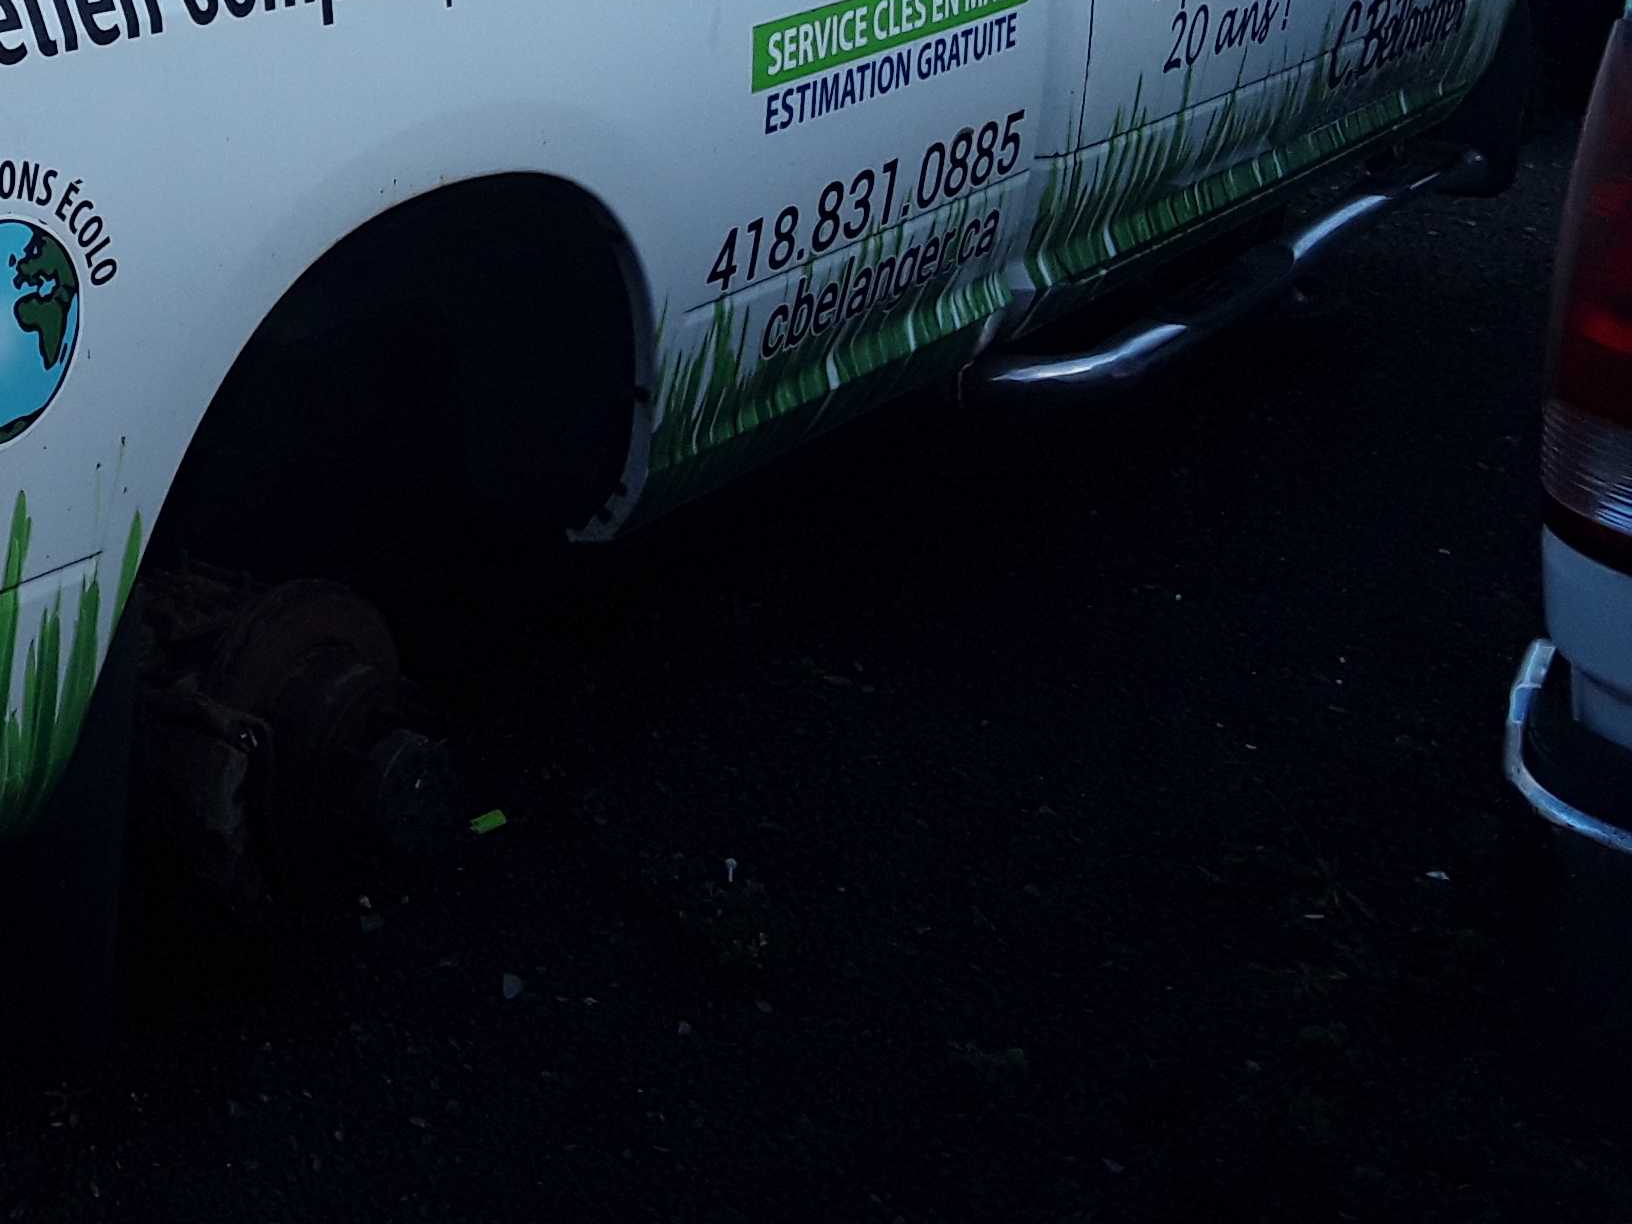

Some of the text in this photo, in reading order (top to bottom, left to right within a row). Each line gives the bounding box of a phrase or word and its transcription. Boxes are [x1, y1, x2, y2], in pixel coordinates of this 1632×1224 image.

[765, 13, 1017, 134] ESTIMATION GRATUITE
[767, 6, 868, 75] SERVICE
[1163, 4, 1209, 73] 20
[55, 179, 117, 286] ÉCOLO
[706, 110, 1025, 291] 418.831.0885
